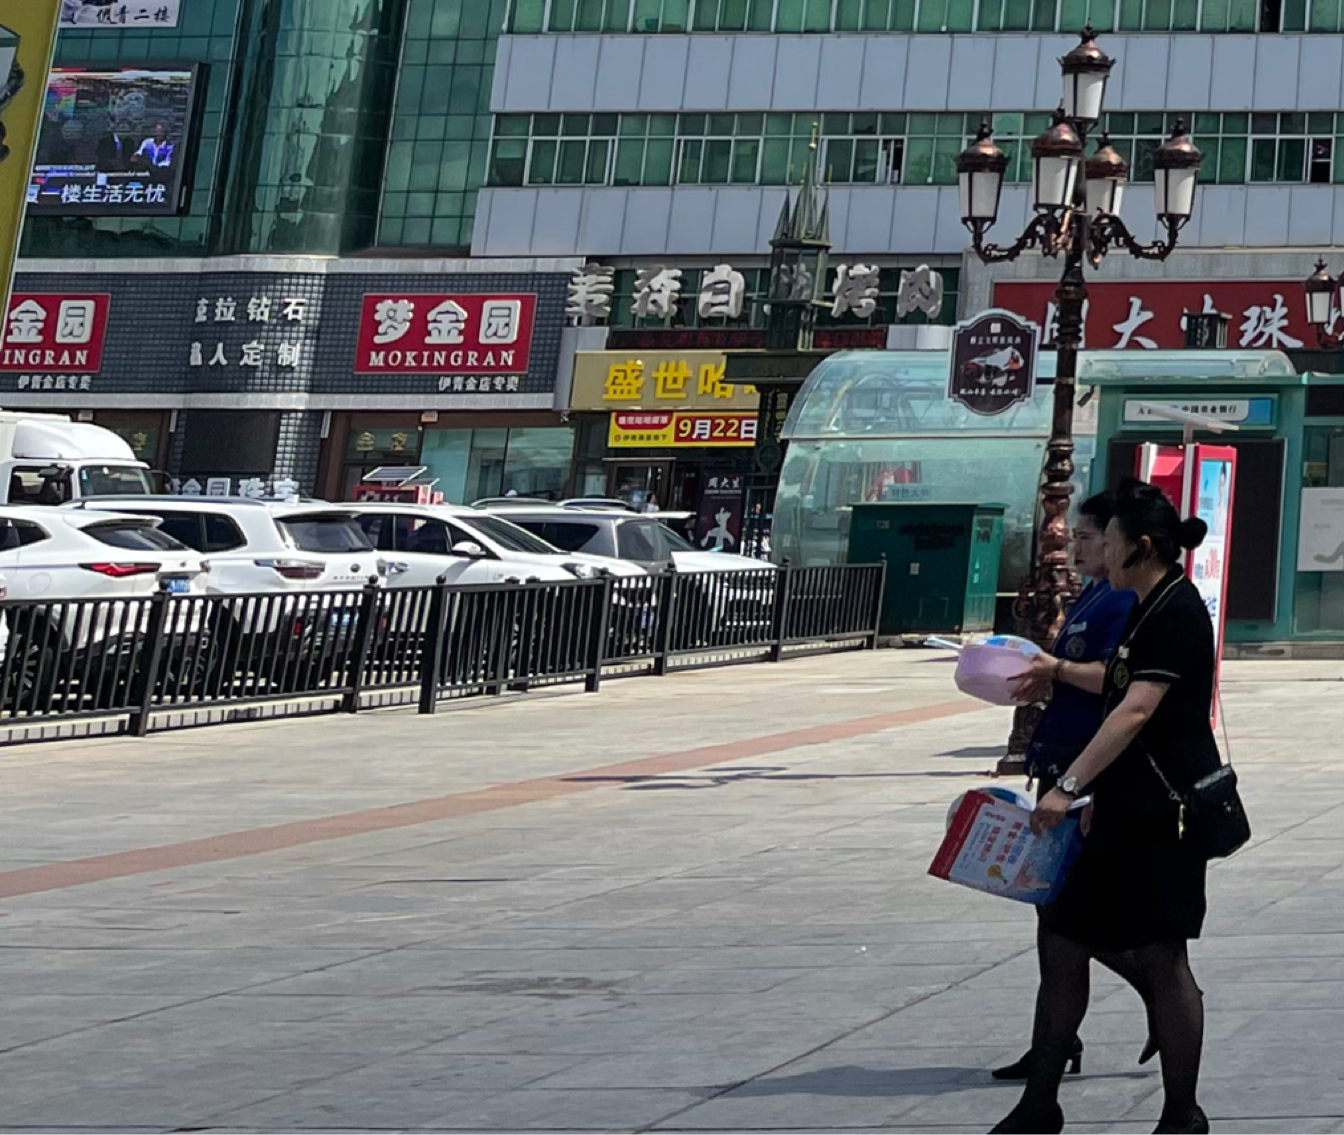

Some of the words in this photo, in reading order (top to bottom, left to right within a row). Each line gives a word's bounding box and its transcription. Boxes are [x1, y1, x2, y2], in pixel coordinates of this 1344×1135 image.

[6, 299, 96, 345] 金园
[373, 298, 521, 345] 梦金园
[369, 351, 516, 367] MOKINGRAN
[602, 359, 758, 400] 盛世哈
[677, 418, 758, 440] 9月22日
